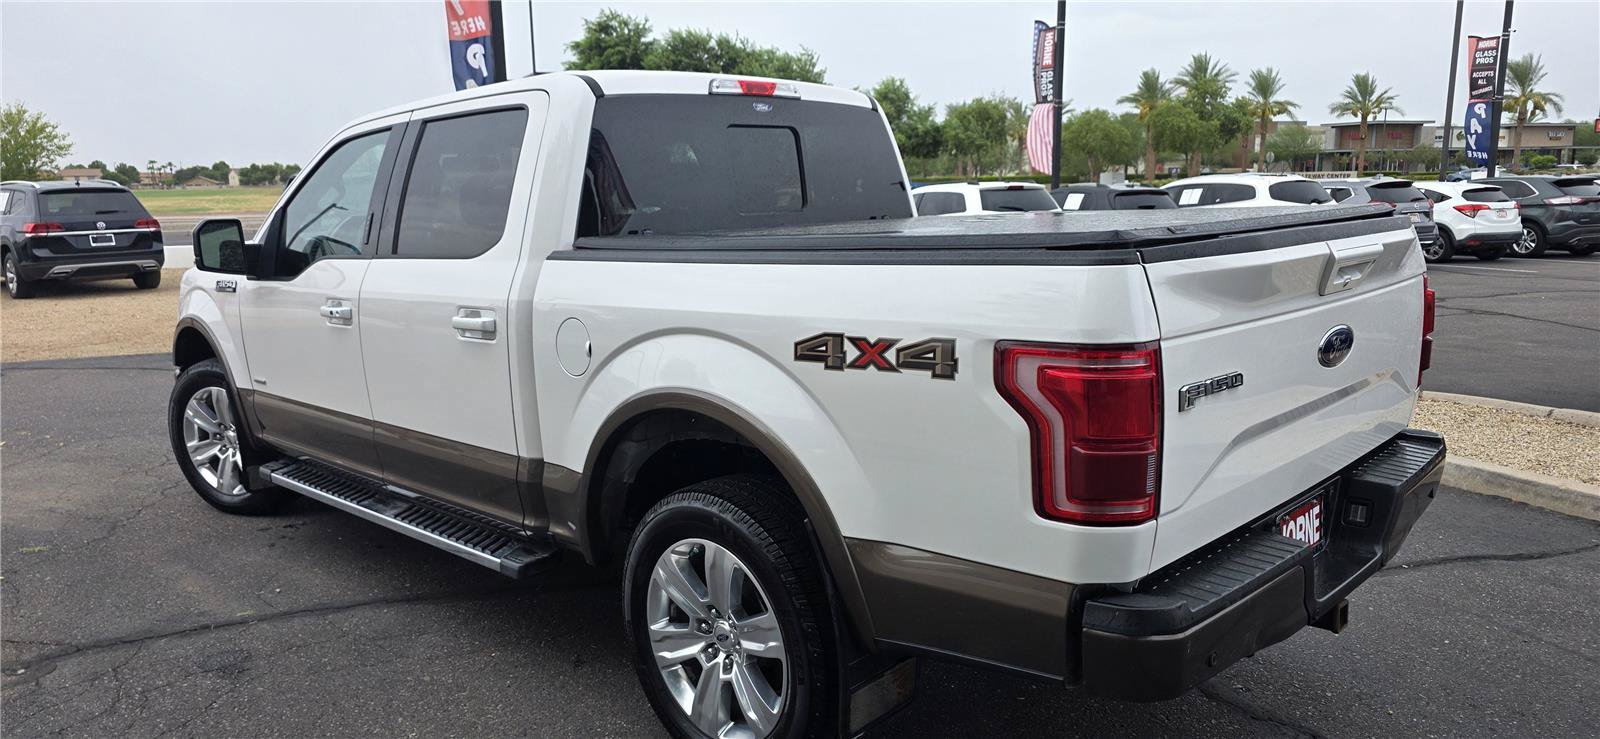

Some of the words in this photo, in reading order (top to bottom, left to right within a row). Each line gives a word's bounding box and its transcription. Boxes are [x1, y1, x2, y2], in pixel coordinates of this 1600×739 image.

[1042, 32, 1055, 66] HORNE
[1477, 40, 1497, 49] HORNE
[1475, 49, 1497, 58] GLASS
[1475, 57, 1494, 65] PROS
[1040, 71, 1048, 97] PROS
[1046, 71, 1054, 101] GLASS
